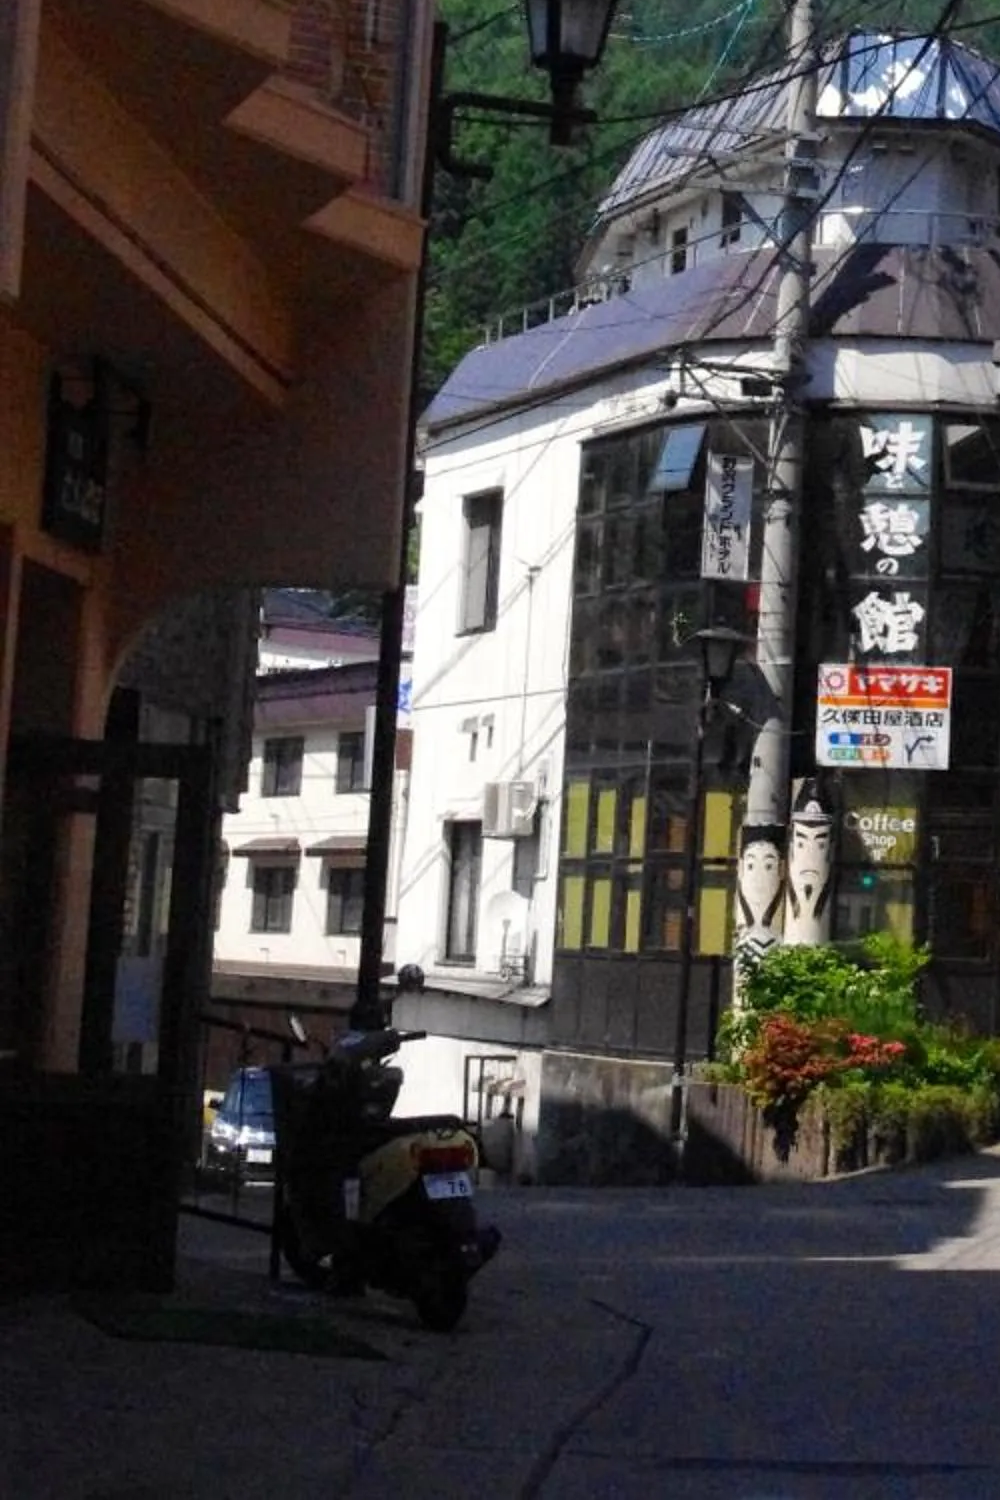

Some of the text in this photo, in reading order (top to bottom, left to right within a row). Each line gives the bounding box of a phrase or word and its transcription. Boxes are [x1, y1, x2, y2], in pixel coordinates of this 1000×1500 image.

[850, 420, 926, 654] 味と憩の館
[822, 708, 945, 728] 久保田屋酒店
[844, 811, 915, 832] Coffee
